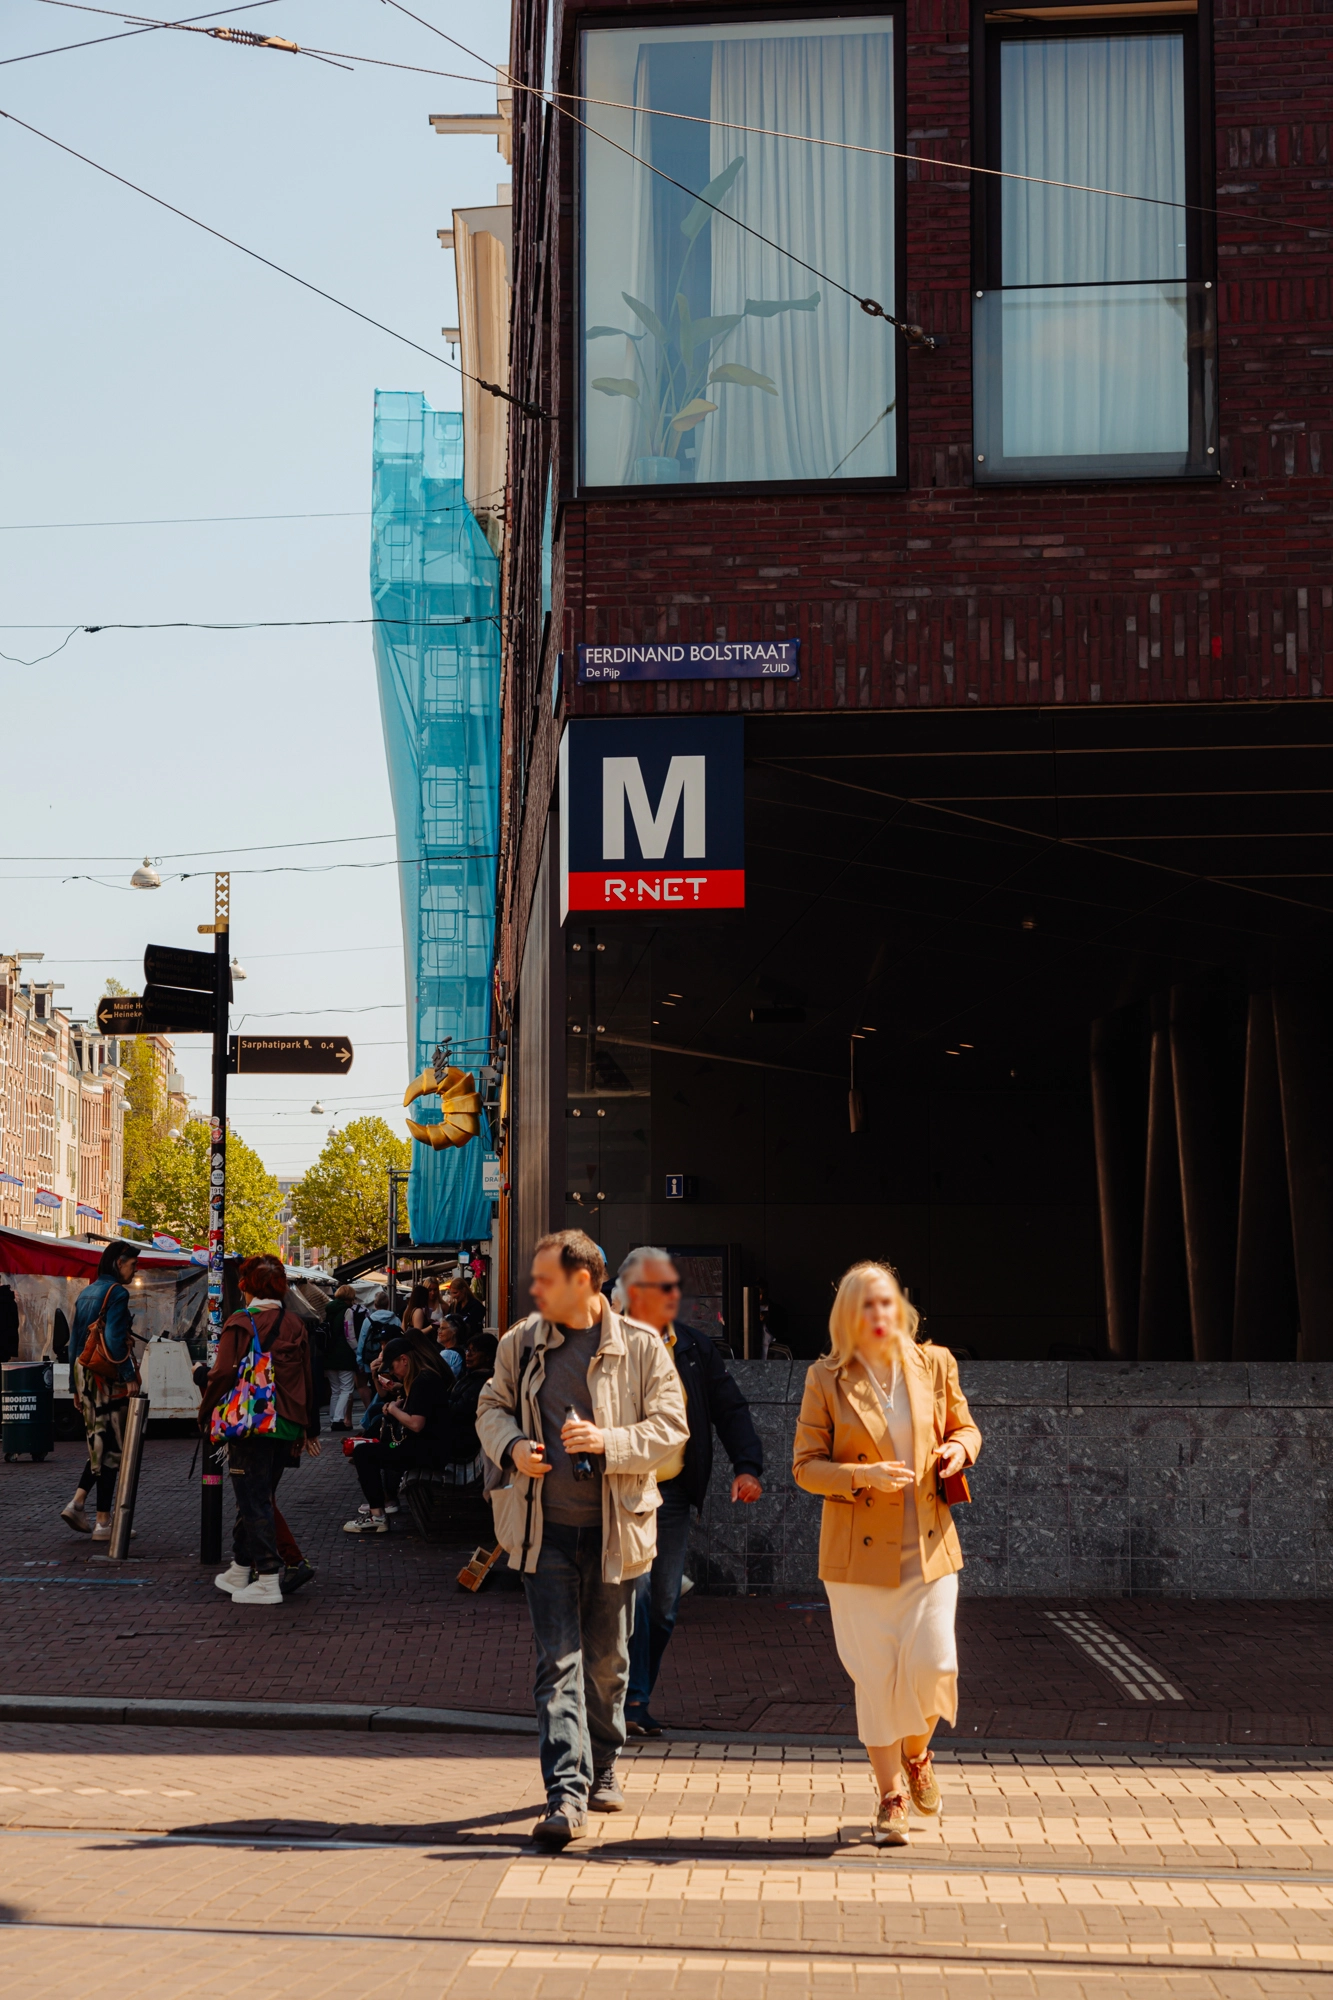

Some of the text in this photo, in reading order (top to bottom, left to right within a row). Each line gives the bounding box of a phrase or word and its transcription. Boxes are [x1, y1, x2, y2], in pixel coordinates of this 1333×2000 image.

[585, 643, 790, 664] FERDINAND BOLSTRAAT
[586, 667, 621, 680] De Pijp
[762, 663, 790, 674] ZUID
[602, 755, 706, 860] M
[241, 1040, 335, 1051] Sarphatipark 0,4
